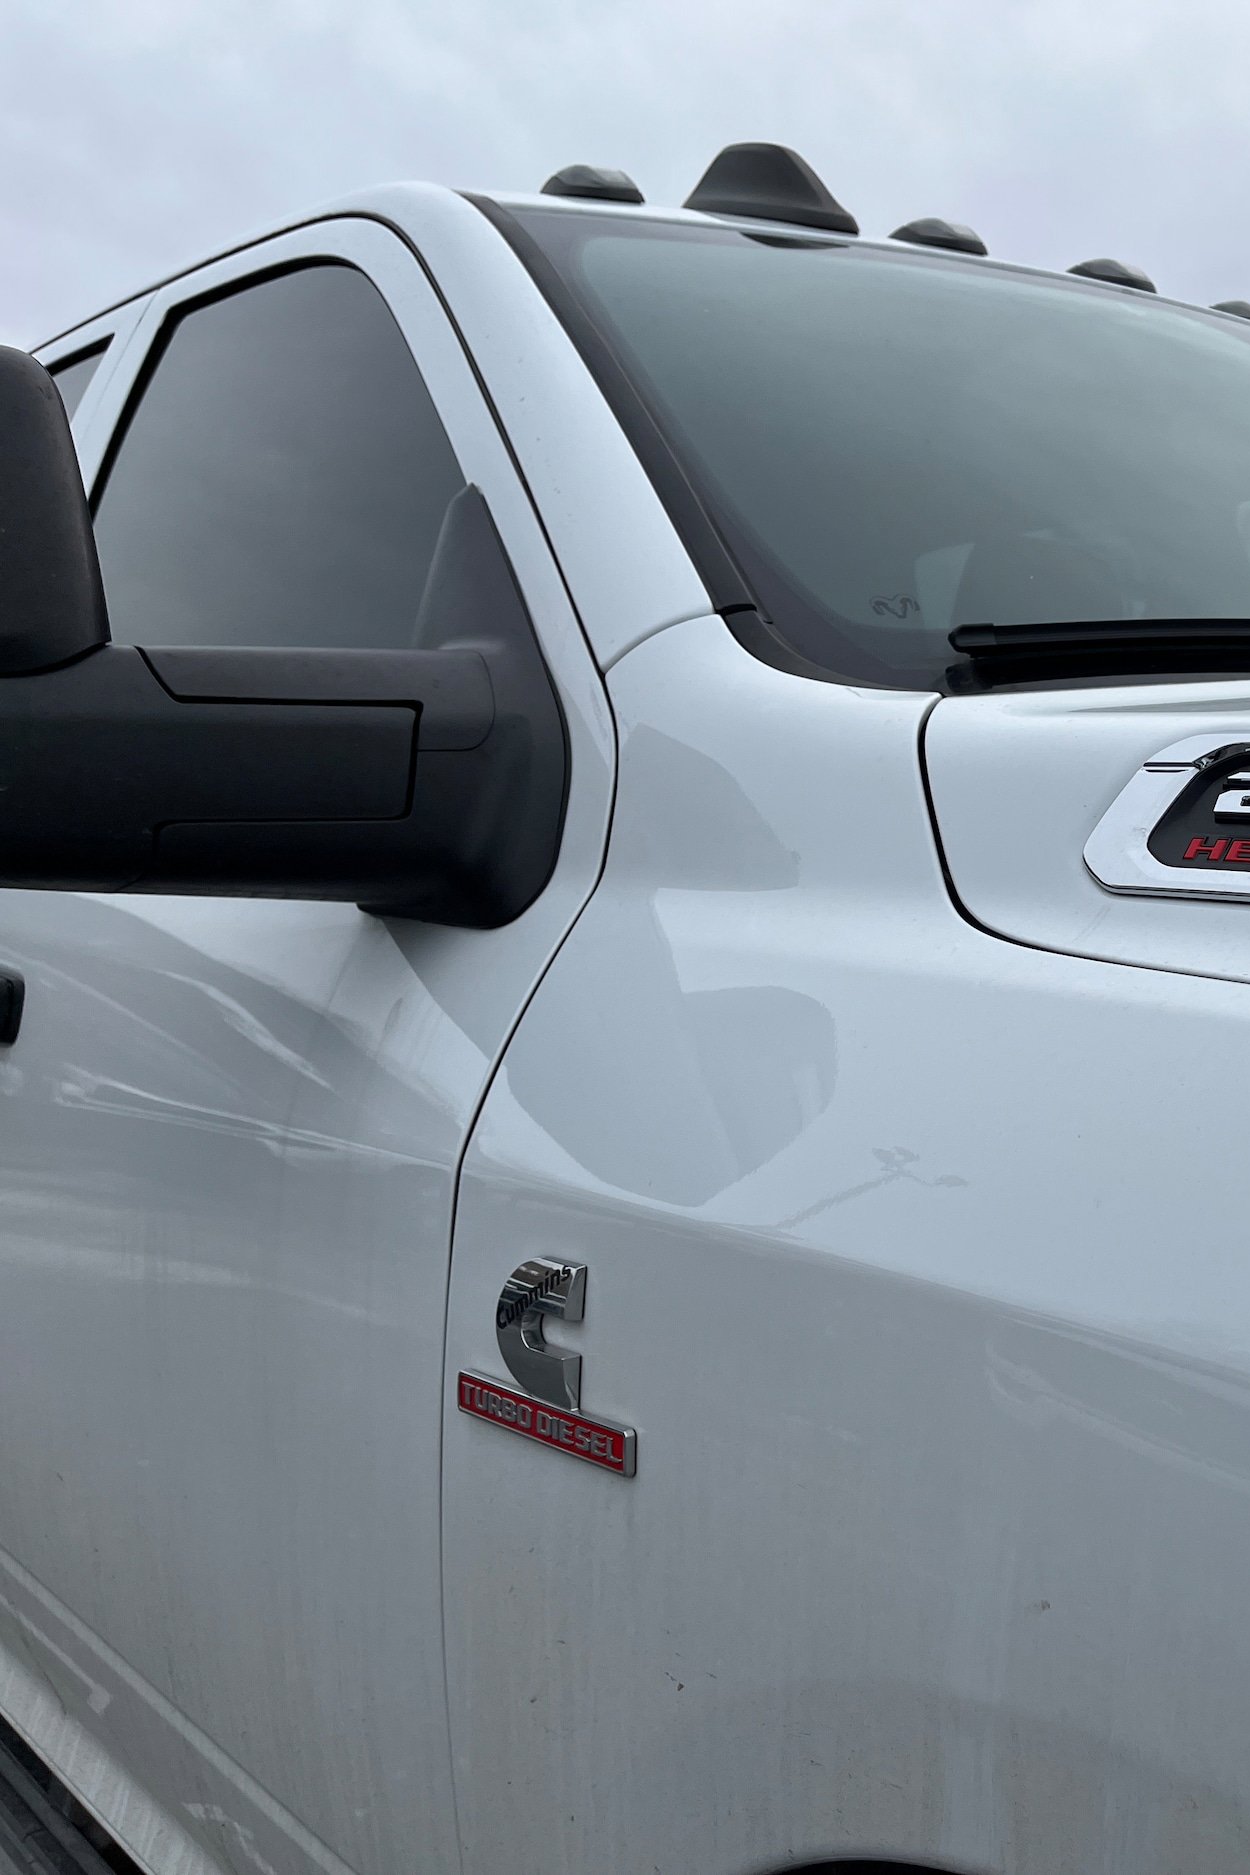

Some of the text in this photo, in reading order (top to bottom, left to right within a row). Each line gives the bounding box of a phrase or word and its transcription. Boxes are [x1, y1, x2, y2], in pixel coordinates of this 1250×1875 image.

[496, 1265, 571, 1329] Cummins
[461, 1382, 623, 1463] TURBO DIESEL
